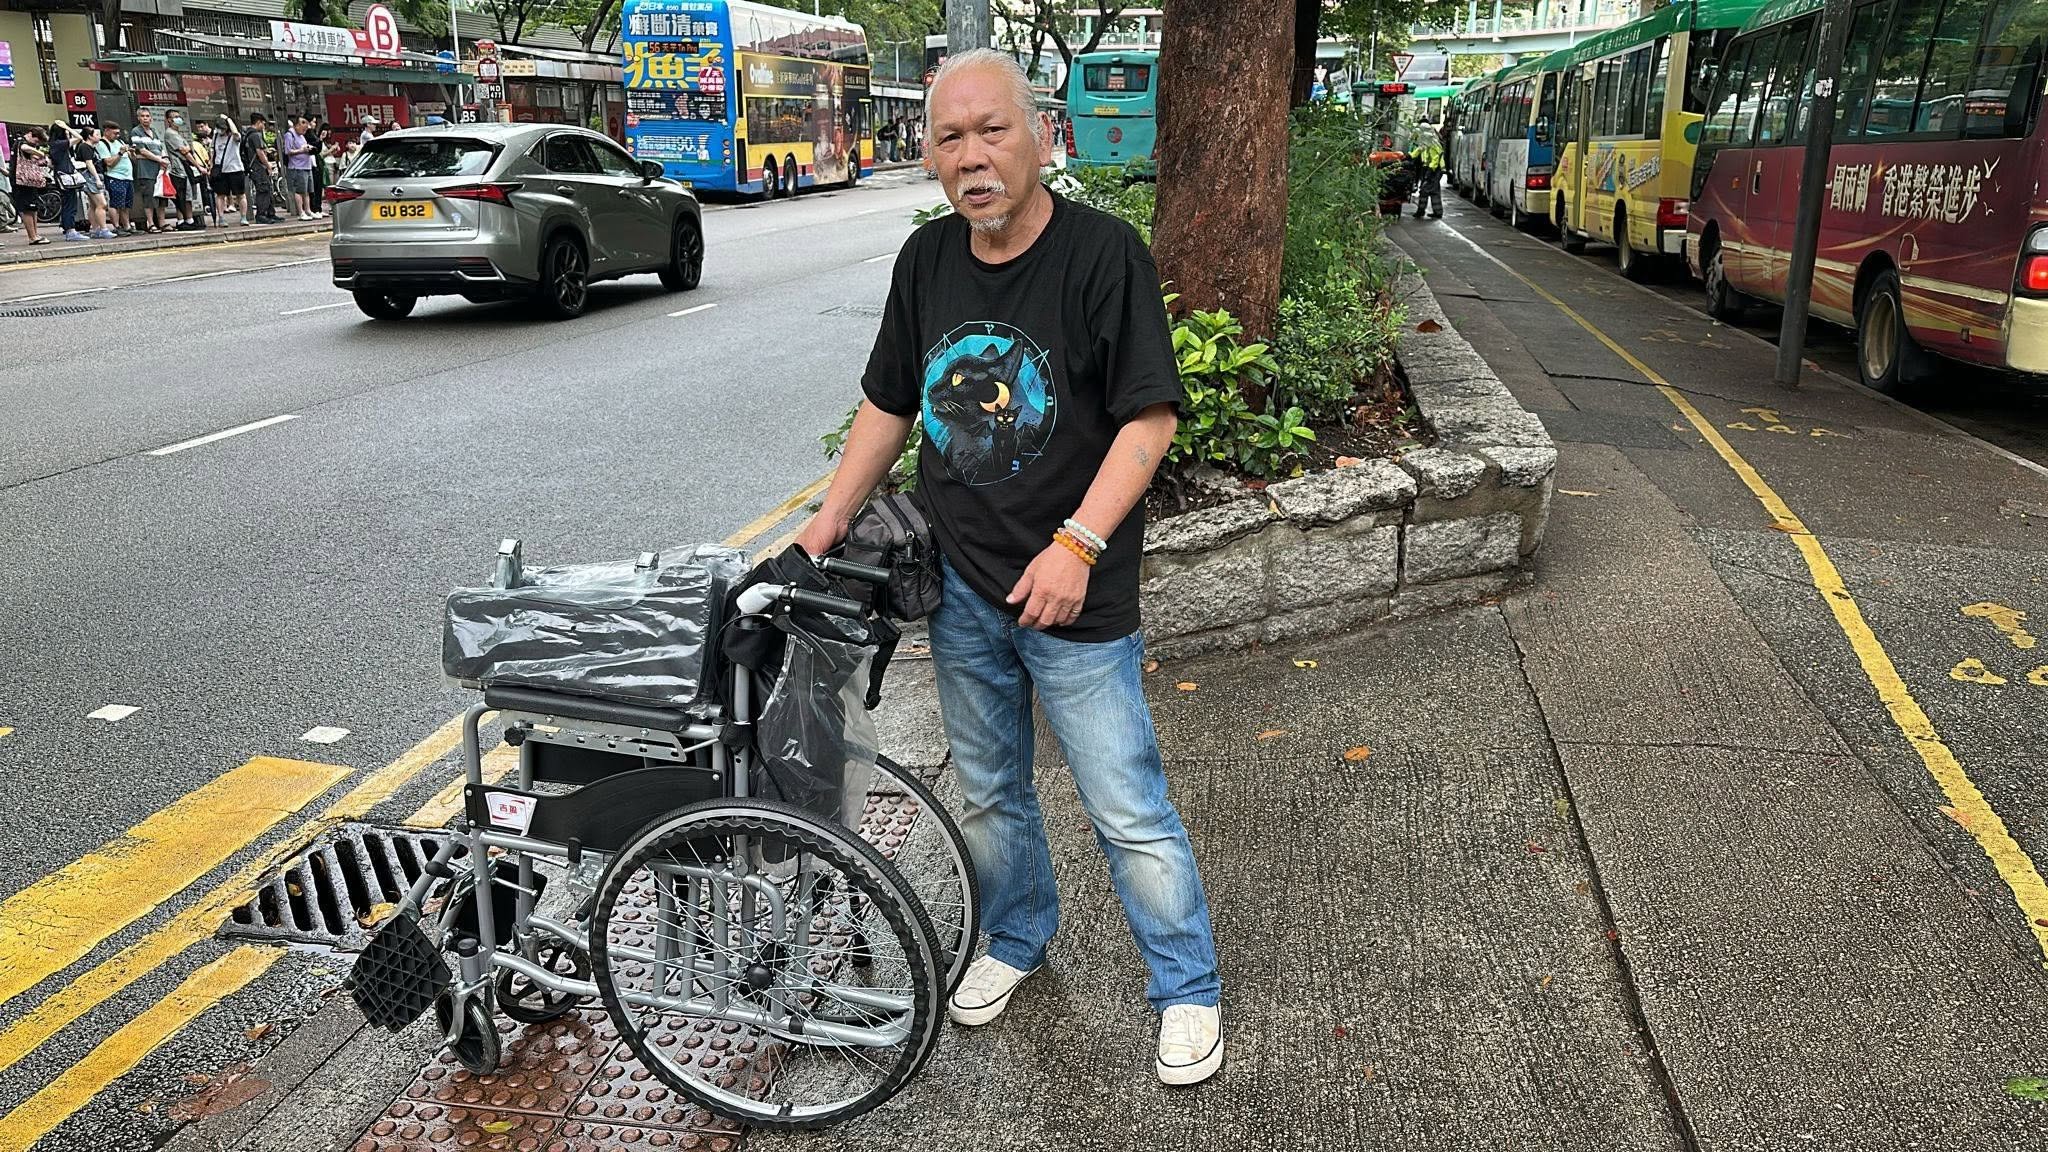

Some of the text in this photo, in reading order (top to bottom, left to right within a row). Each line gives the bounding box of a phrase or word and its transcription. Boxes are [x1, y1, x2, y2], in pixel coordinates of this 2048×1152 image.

[375, 15, 393, 50] B
[649, 42, 660, 53] 56
[74, 96, 87, 105] B6
[73, 113, 94, 126] 70K
[1882, 164, 1981, 224] 香港繁榮進步
[380, 205, 425, 217] GU 832
